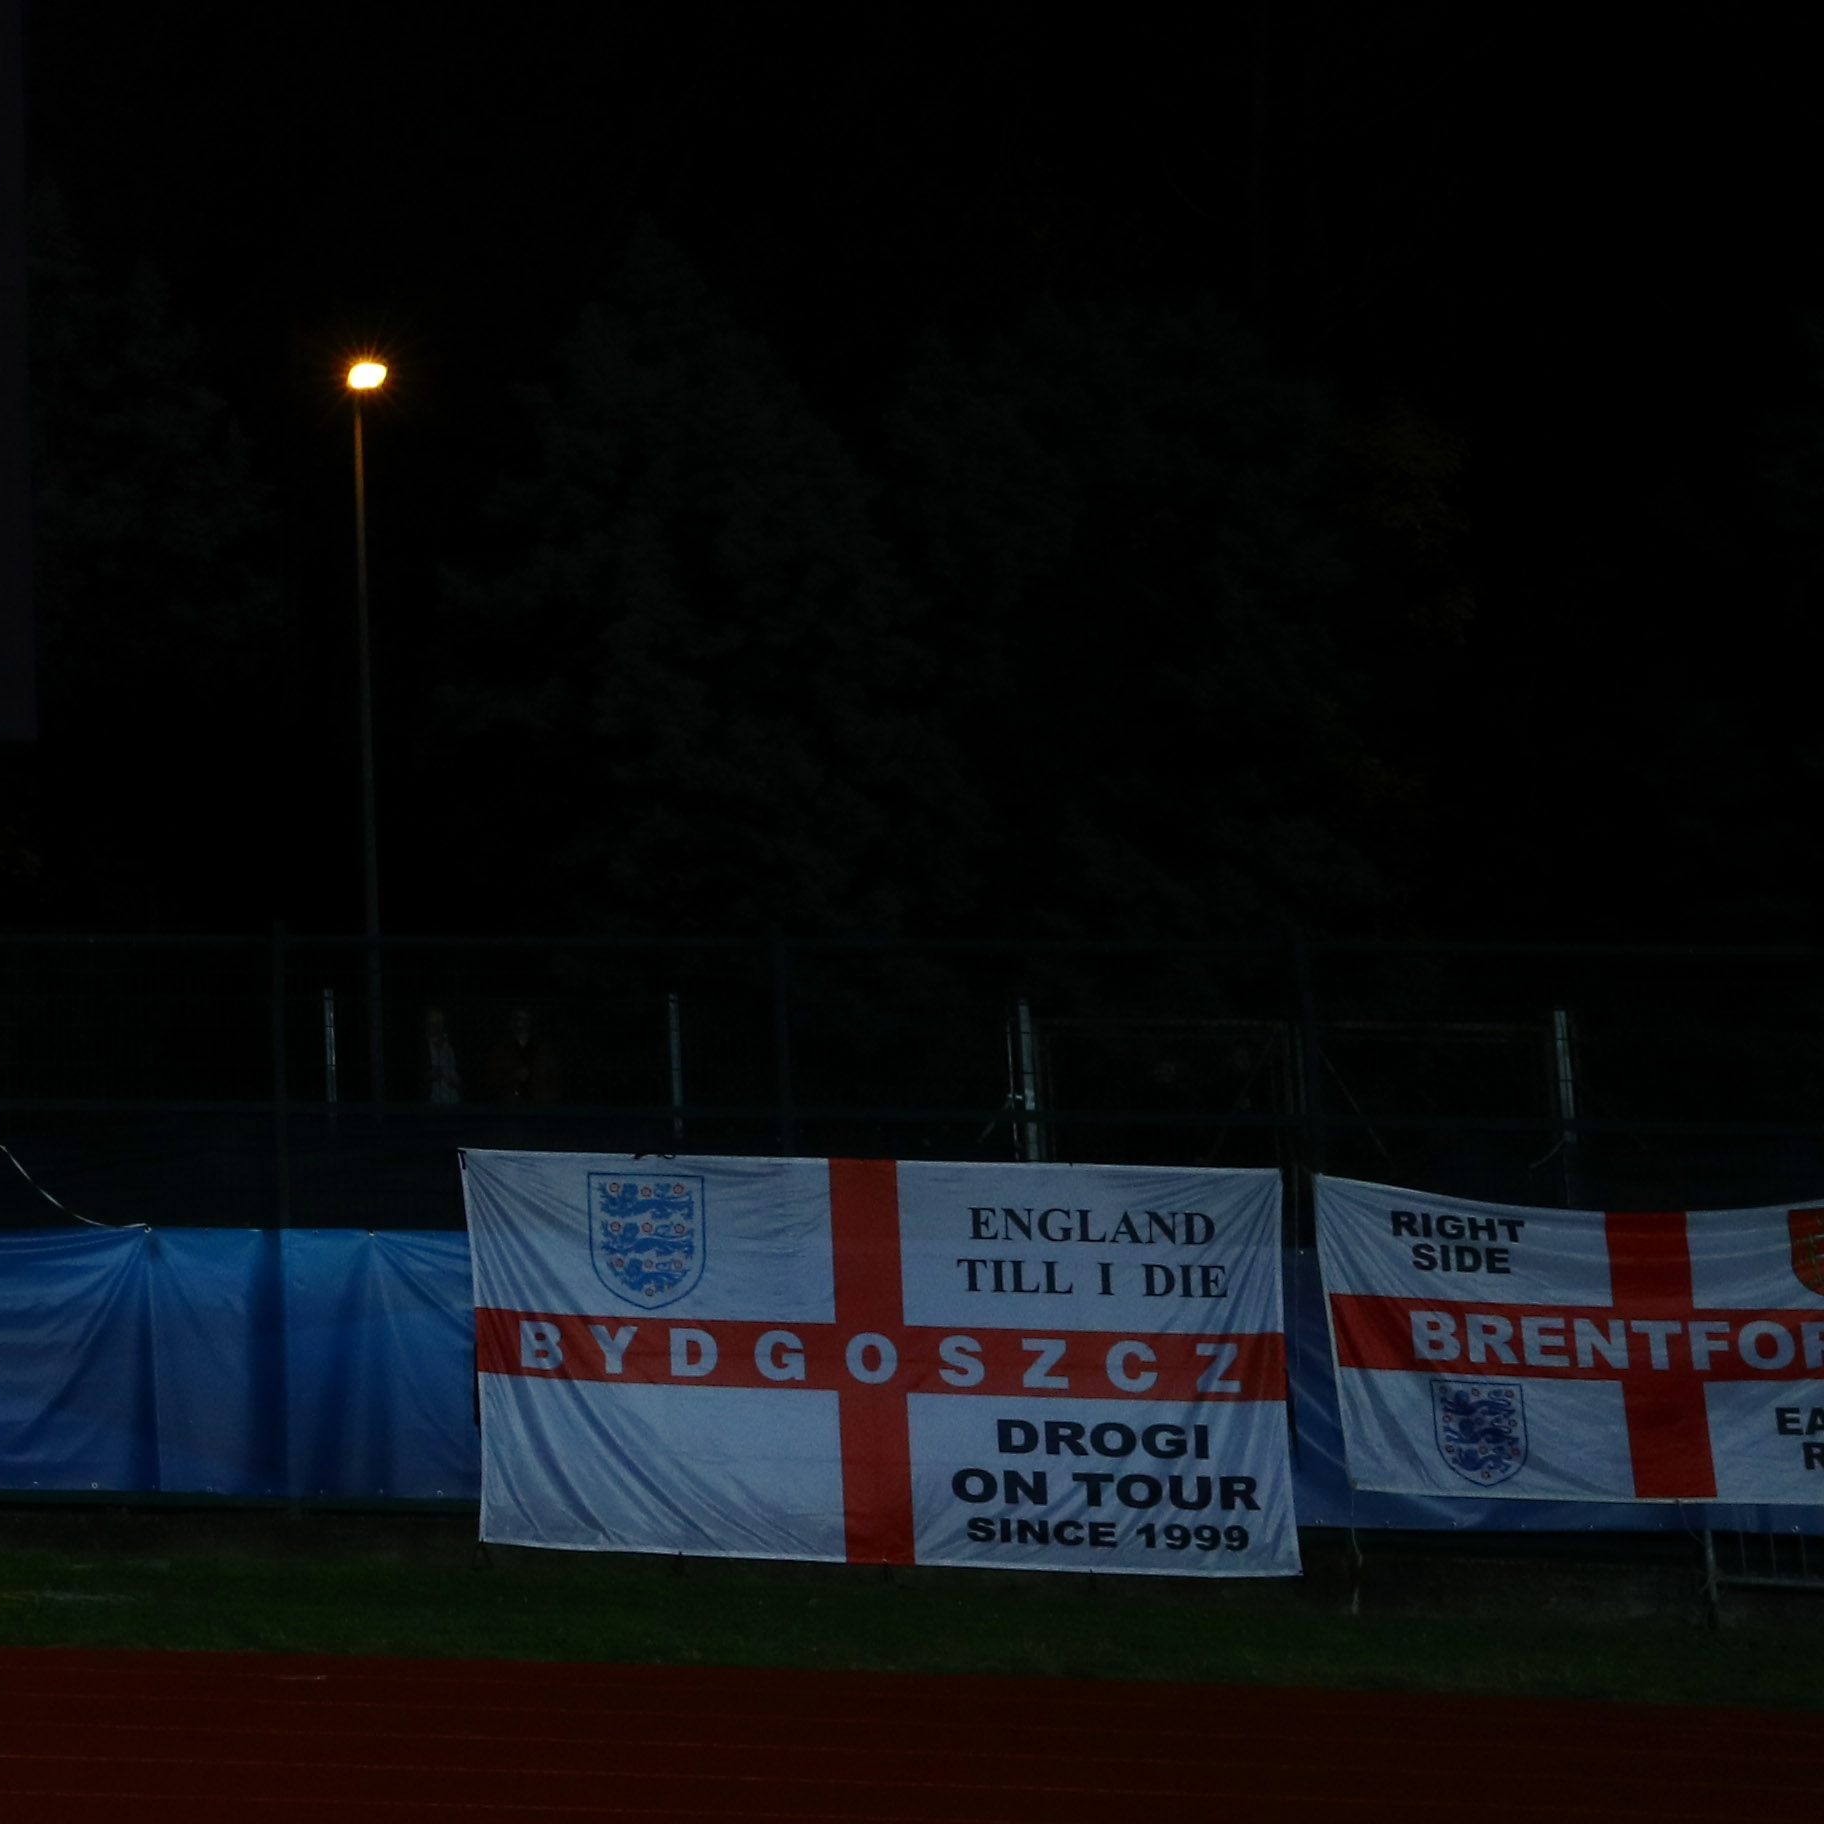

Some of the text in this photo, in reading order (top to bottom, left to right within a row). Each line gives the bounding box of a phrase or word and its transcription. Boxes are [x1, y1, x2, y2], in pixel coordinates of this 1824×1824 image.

[967, 1207, 1215, 1245] ENGLAND
[1390, 1210, 1525, 1243] RIGHT
[957, 1258, 1228, 1298] TILL I DIE
[1411, 1243, 1511, 1274] SIDE
[519, 1320, 1243, 1394] BYDGOSZCZ
[997, 1419, 1210, 1460] DROGI
[951, 1468, 1261, 1511] ON TOUR
[966, 1517, 1250, 1551] SINCE 1999
